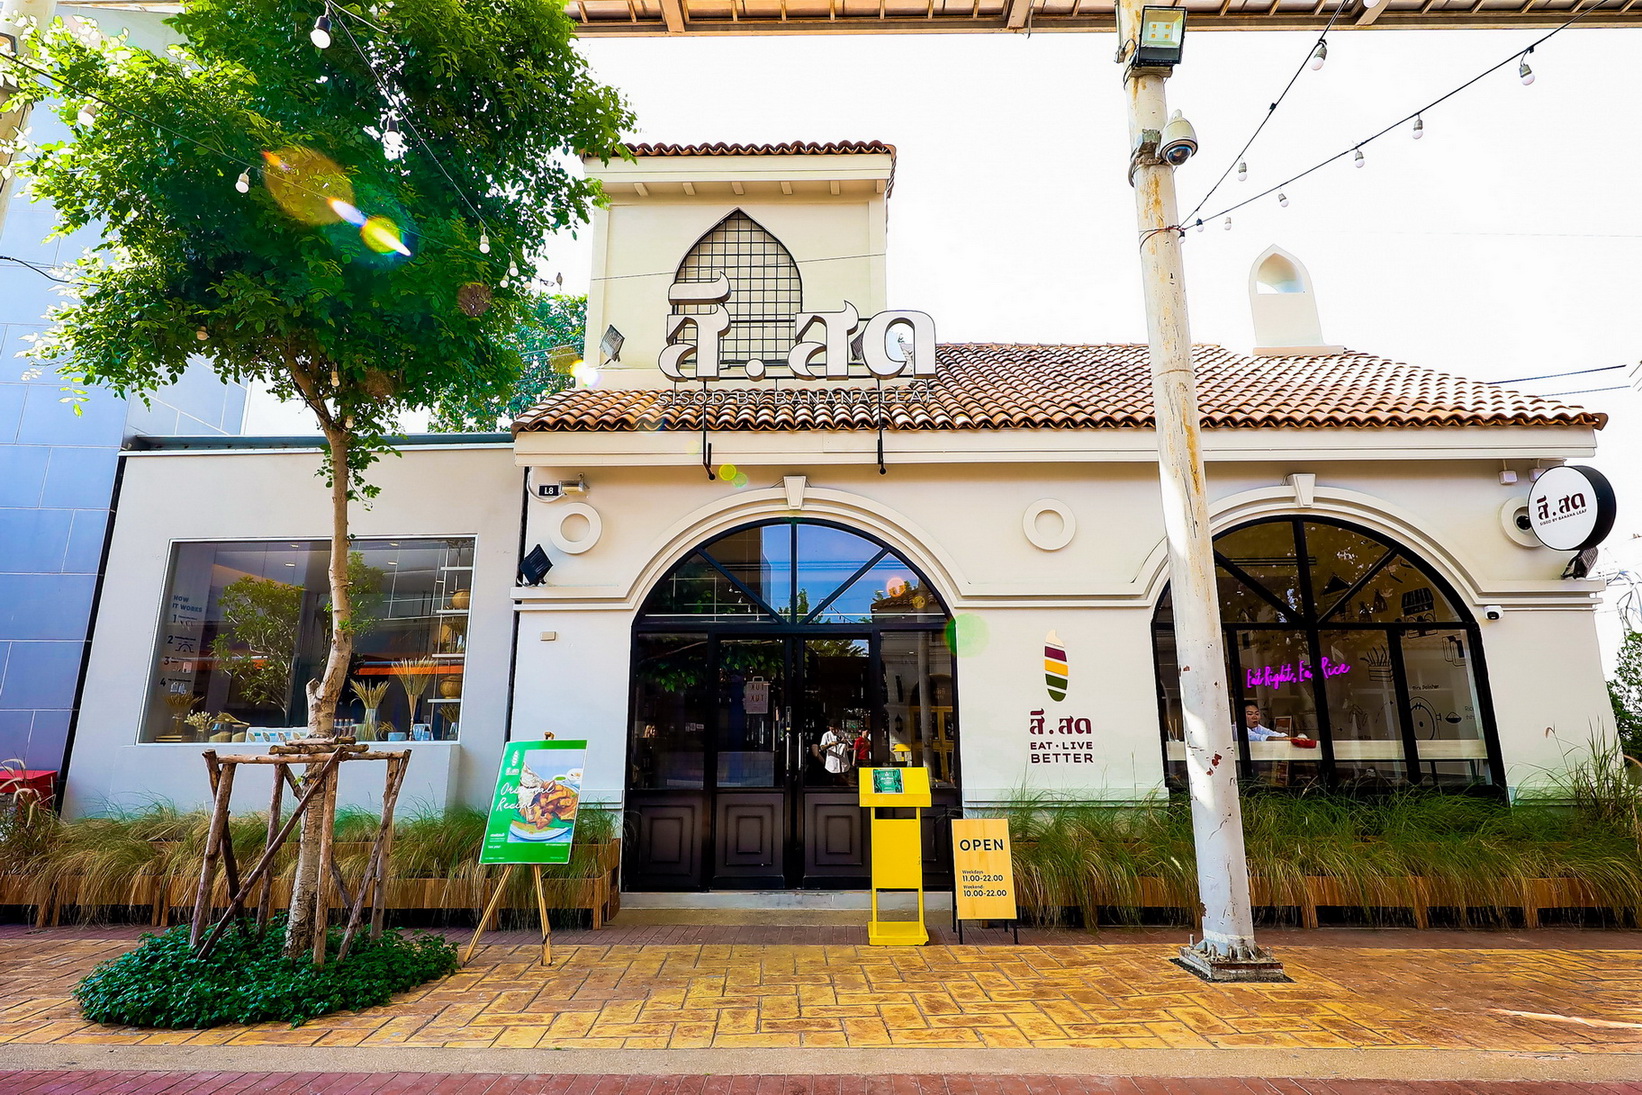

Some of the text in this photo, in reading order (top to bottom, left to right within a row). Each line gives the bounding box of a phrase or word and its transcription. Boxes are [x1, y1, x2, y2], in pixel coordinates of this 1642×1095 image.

[658, 389, 937, 406] SISOD BY BANANA LEAF
[544, 487, 554, 495] L8
[173, 594, 189, 602] HOW
[180, 604, 203, 612] WORKS
[167, 635, 173, 644] 2
[163, 656, 170, 665] 3
[1246, 667, 1264, 688] Eat
[1299, 660, 1313, 682] Ea
[160, 677, 166, 687] 4
[1030, 741, 1093, 750] EAT LIVE
[1030, 753, 1094, 764] BETTER
[501, 781, 555, 796] Orinal
[959, 838, 1004, 851] OPEN
[962, 874, 1004, 882] 11.00-22.00
[963, 889, 1007, 897] 10.00-22.00
